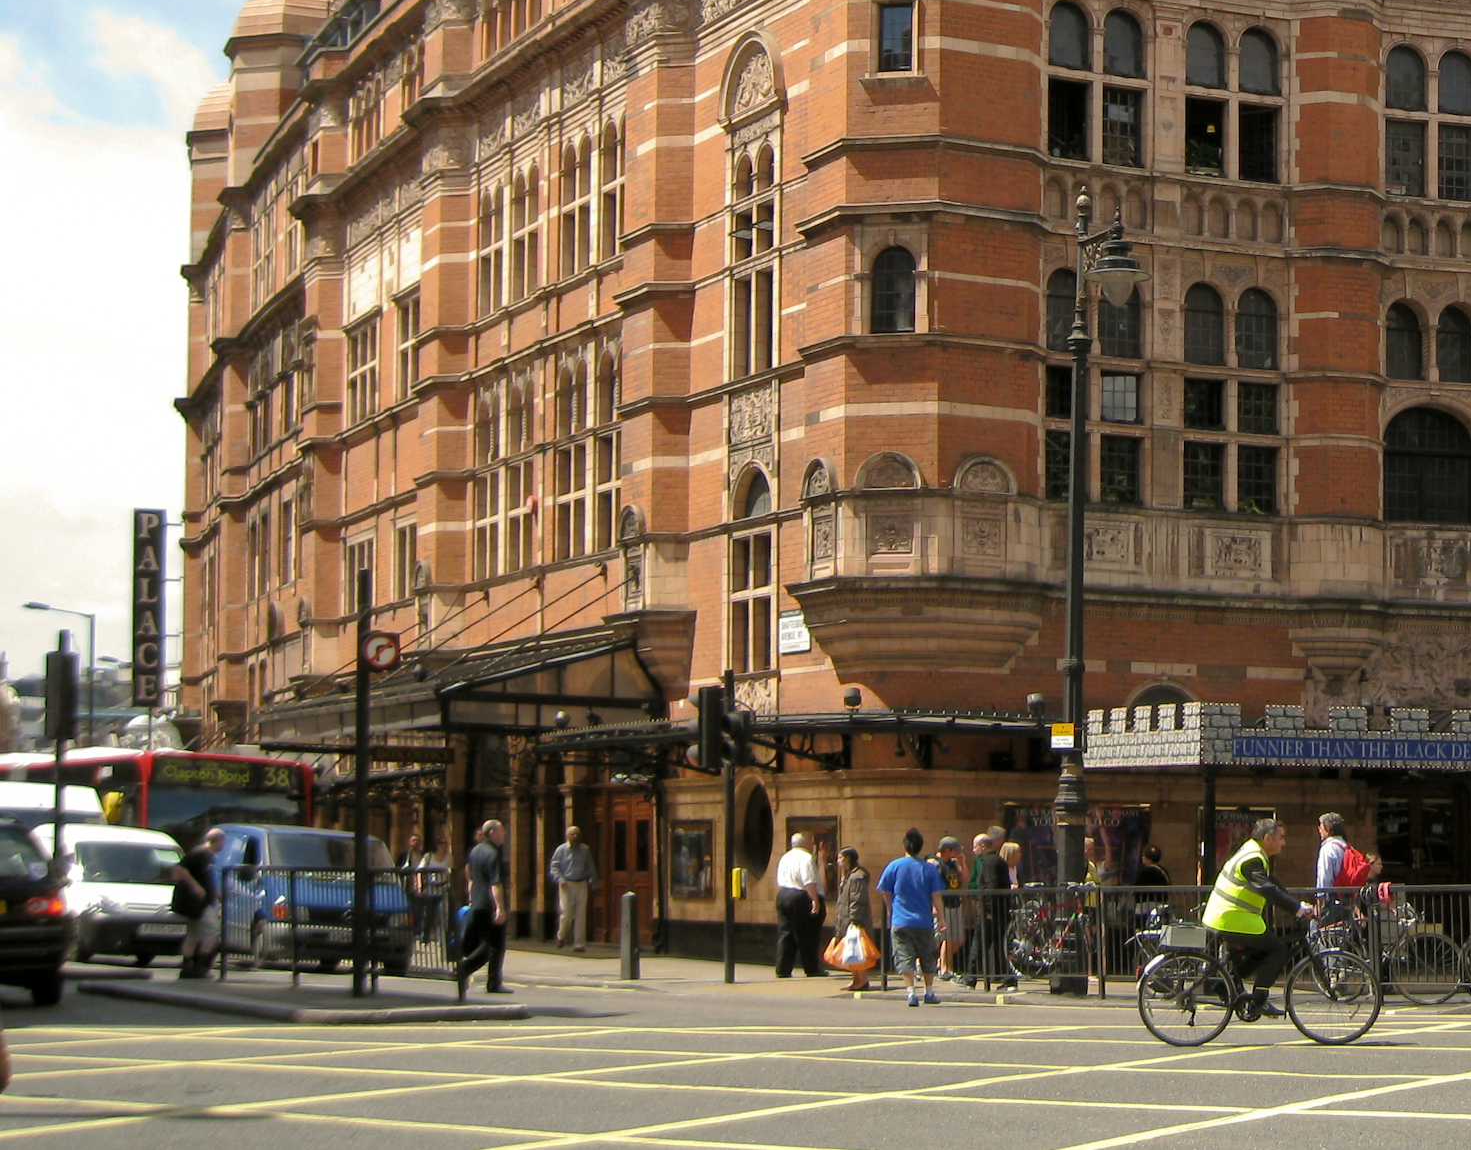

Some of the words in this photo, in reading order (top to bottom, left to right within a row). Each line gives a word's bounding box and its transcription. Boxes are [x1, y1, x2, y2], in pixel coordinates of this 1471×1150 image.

[136, 512, 160, 700] PALACE
[1233, 739, 1304, 756] FUNNIER
[1309, 740, 1354, 757] THAN
[1359, 741, 1390, 758] THE
[1394, 742, 1447, 759] BLACK
[164, 765, 215, 781] Clapton
[220, 768, 250, 783] Pond
[264, 766, 290, 787] 38
